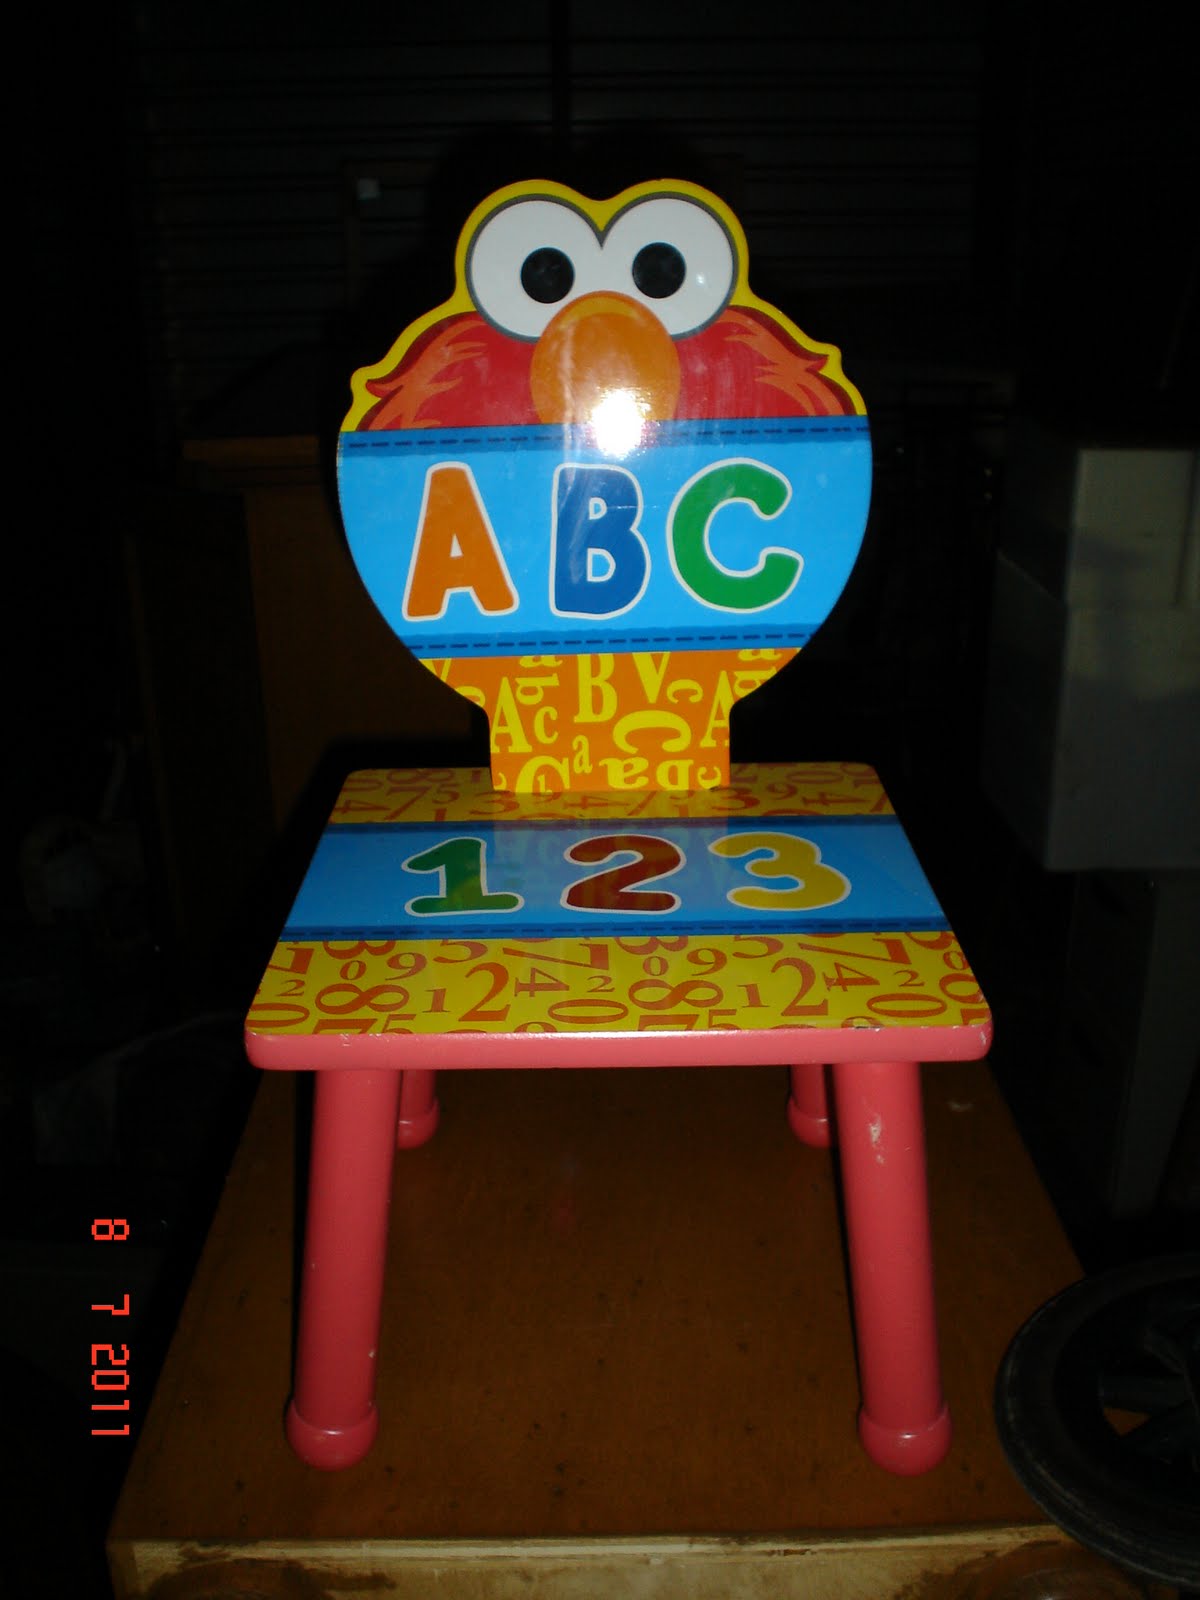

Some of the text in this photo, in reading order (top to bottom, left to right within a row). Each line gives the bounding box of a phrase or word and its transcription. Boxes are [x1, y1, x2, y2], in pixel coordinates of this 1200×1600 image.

[402, 457, 804, 622] ABC
[458, 962, 511, 1022] 2
[770, 957, 829, 1016] 2
